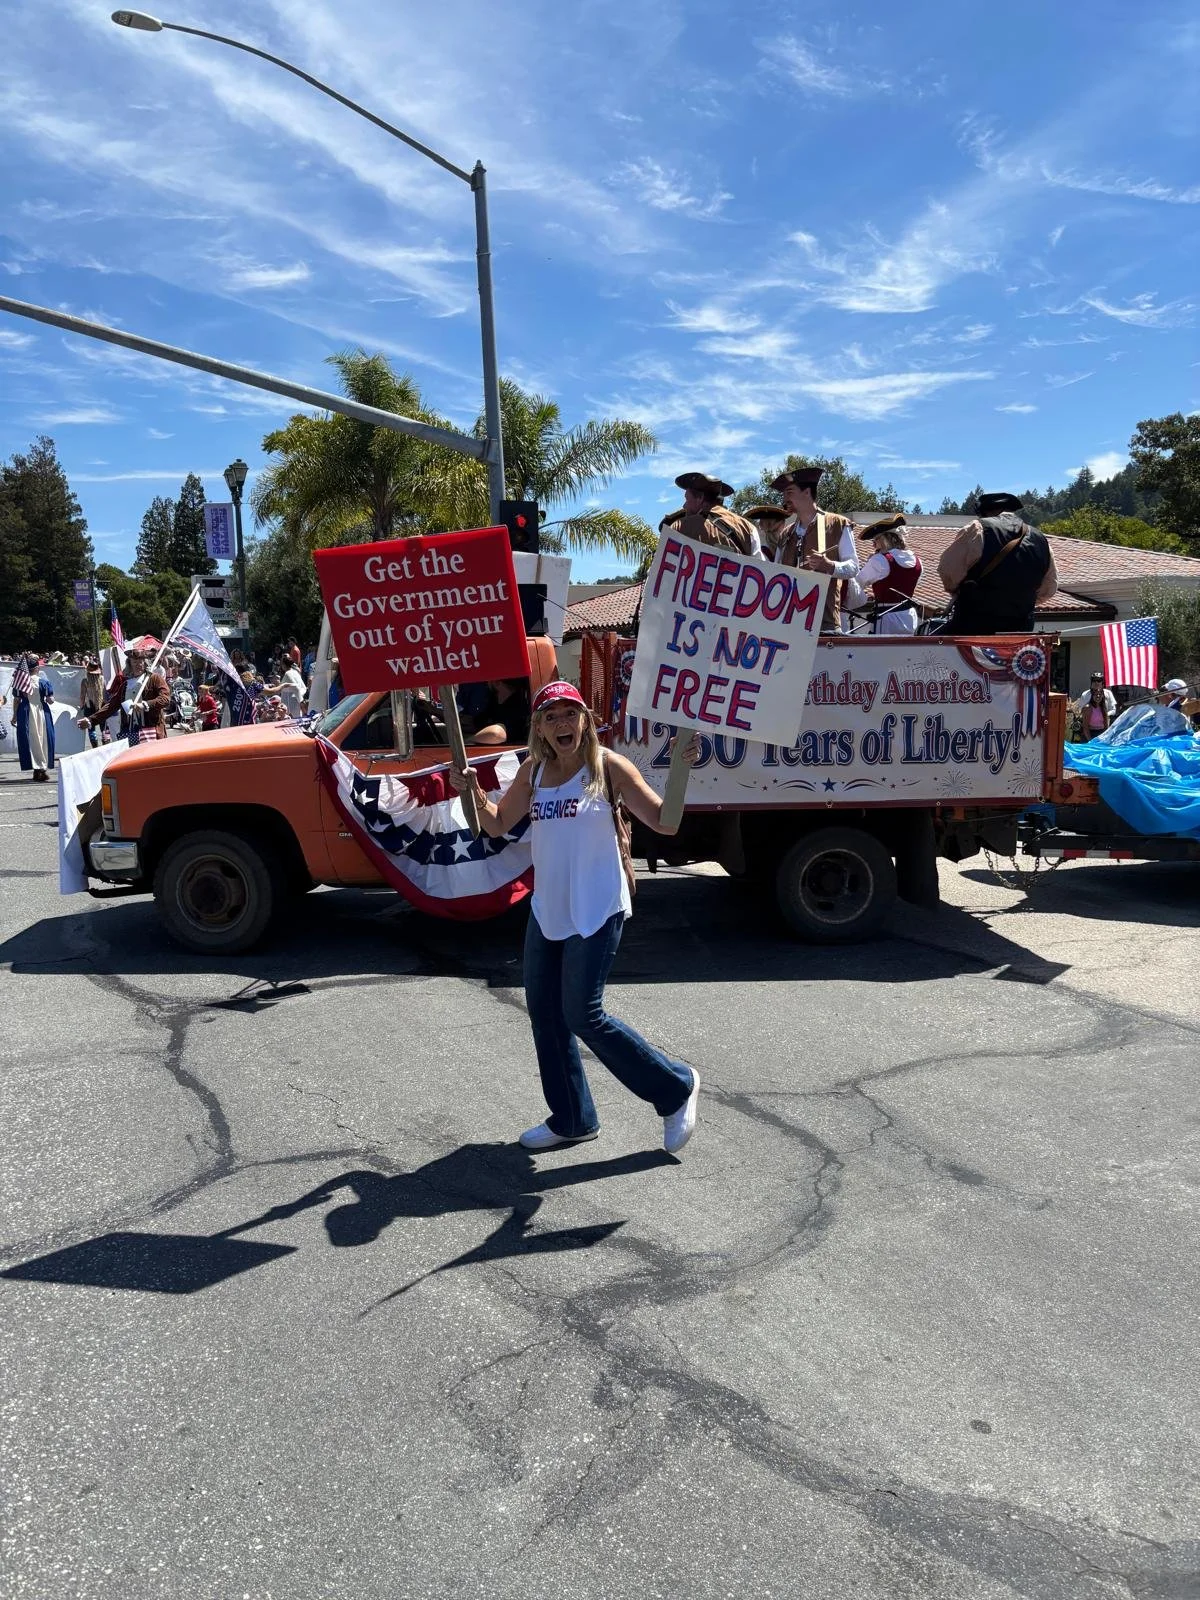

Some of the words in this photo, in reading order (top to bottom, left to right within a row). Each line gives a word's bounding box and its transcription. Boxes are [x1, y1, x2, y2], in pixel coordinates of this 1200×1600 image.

[364, 556, 414, 583] Get
[419, 548, 465, 577] the
[653, 537, 820, 632] FREEDOM
[333, 579, 509, 619] Government
[349, 627, 398, 650] out
[404, 614, 434, 644] of
[439, 615, 504, 648] your
[667, 611, 706, 657] IS
[713, 627, 789, 675] NOT
[386, 644, 481, 676] wallet!
[651, 663, 761, 731] FREE
[804, 671, 878, 712] thday
[882, 672, 993, 704] America!
[861, 713, 897, 763] of
[901, 713, 1022, 774] Liberty!
